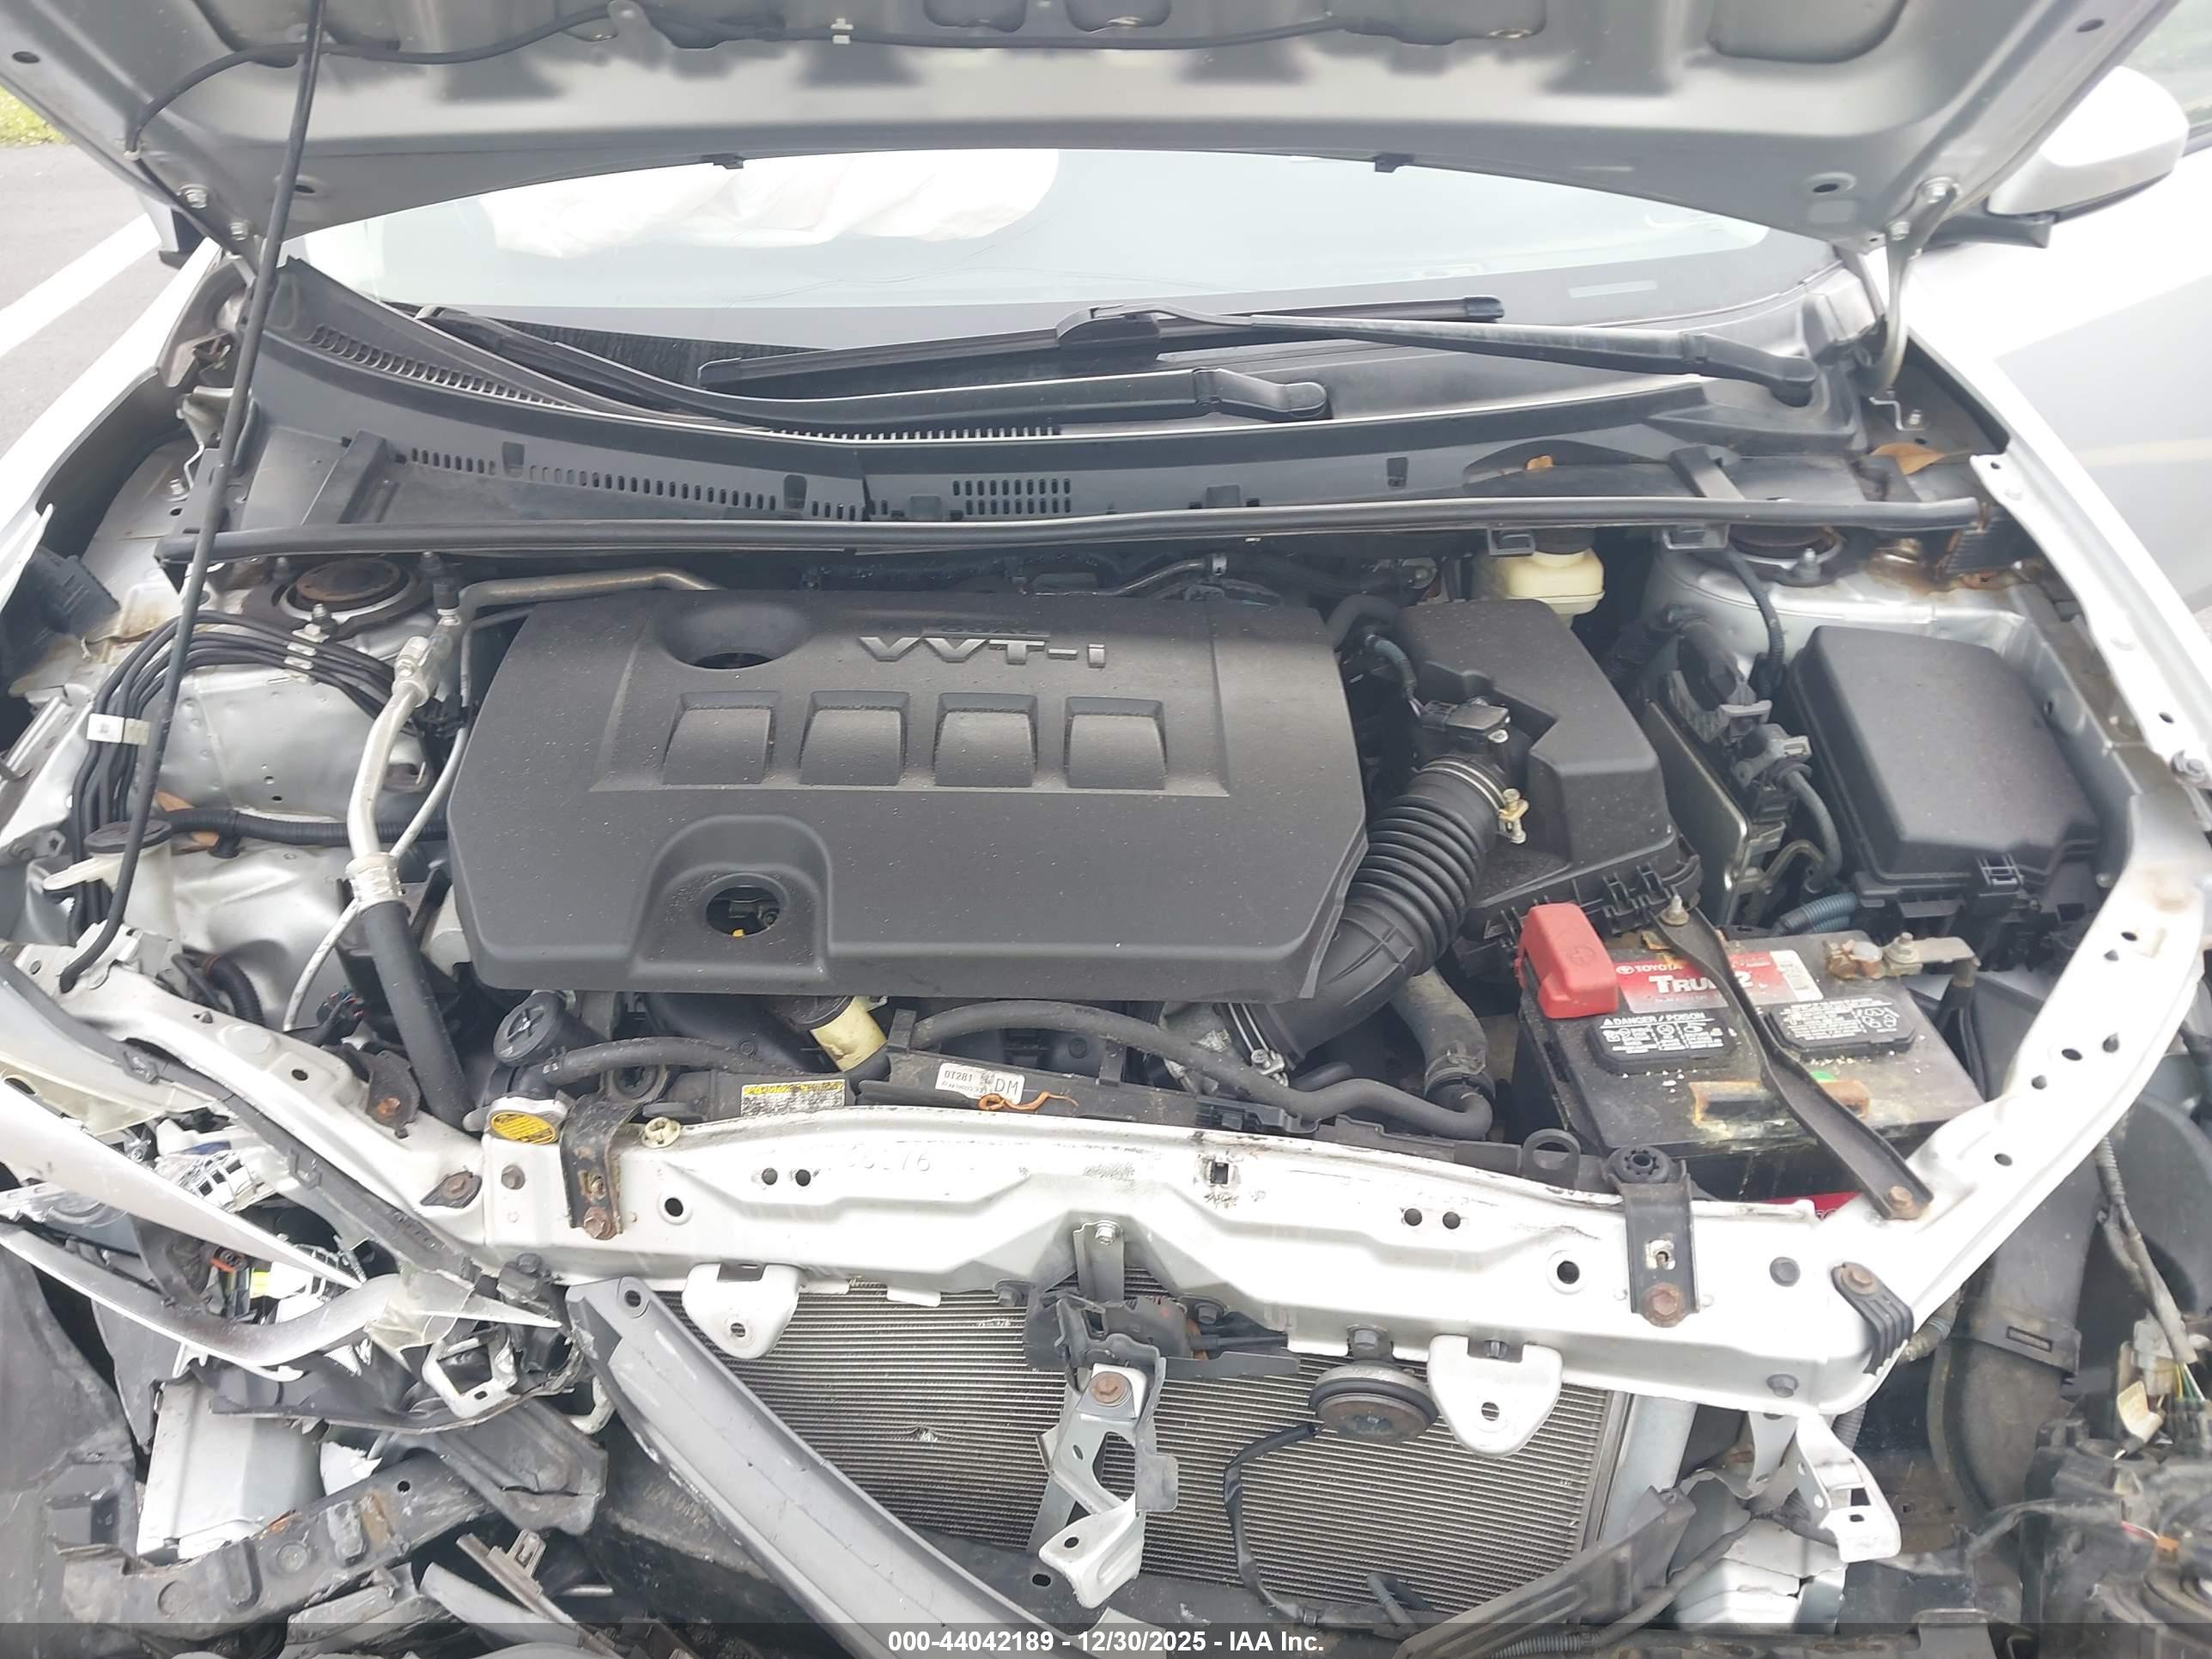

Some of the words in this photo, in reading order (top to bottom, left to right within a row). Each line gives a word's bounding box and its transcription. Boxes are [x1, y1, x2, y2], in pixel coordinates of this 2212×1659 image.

[858, 635, 1106, 669] VVT-i
[1633, 962, 1683, 973] TOYOTA
[1648, 973, 1717, 994] TRU
[1613, 1015, 1657, 1026] DANGER
[1666, 1011, 1706, 1022] POISON
[994, 1078, 1019, 1096] DM
